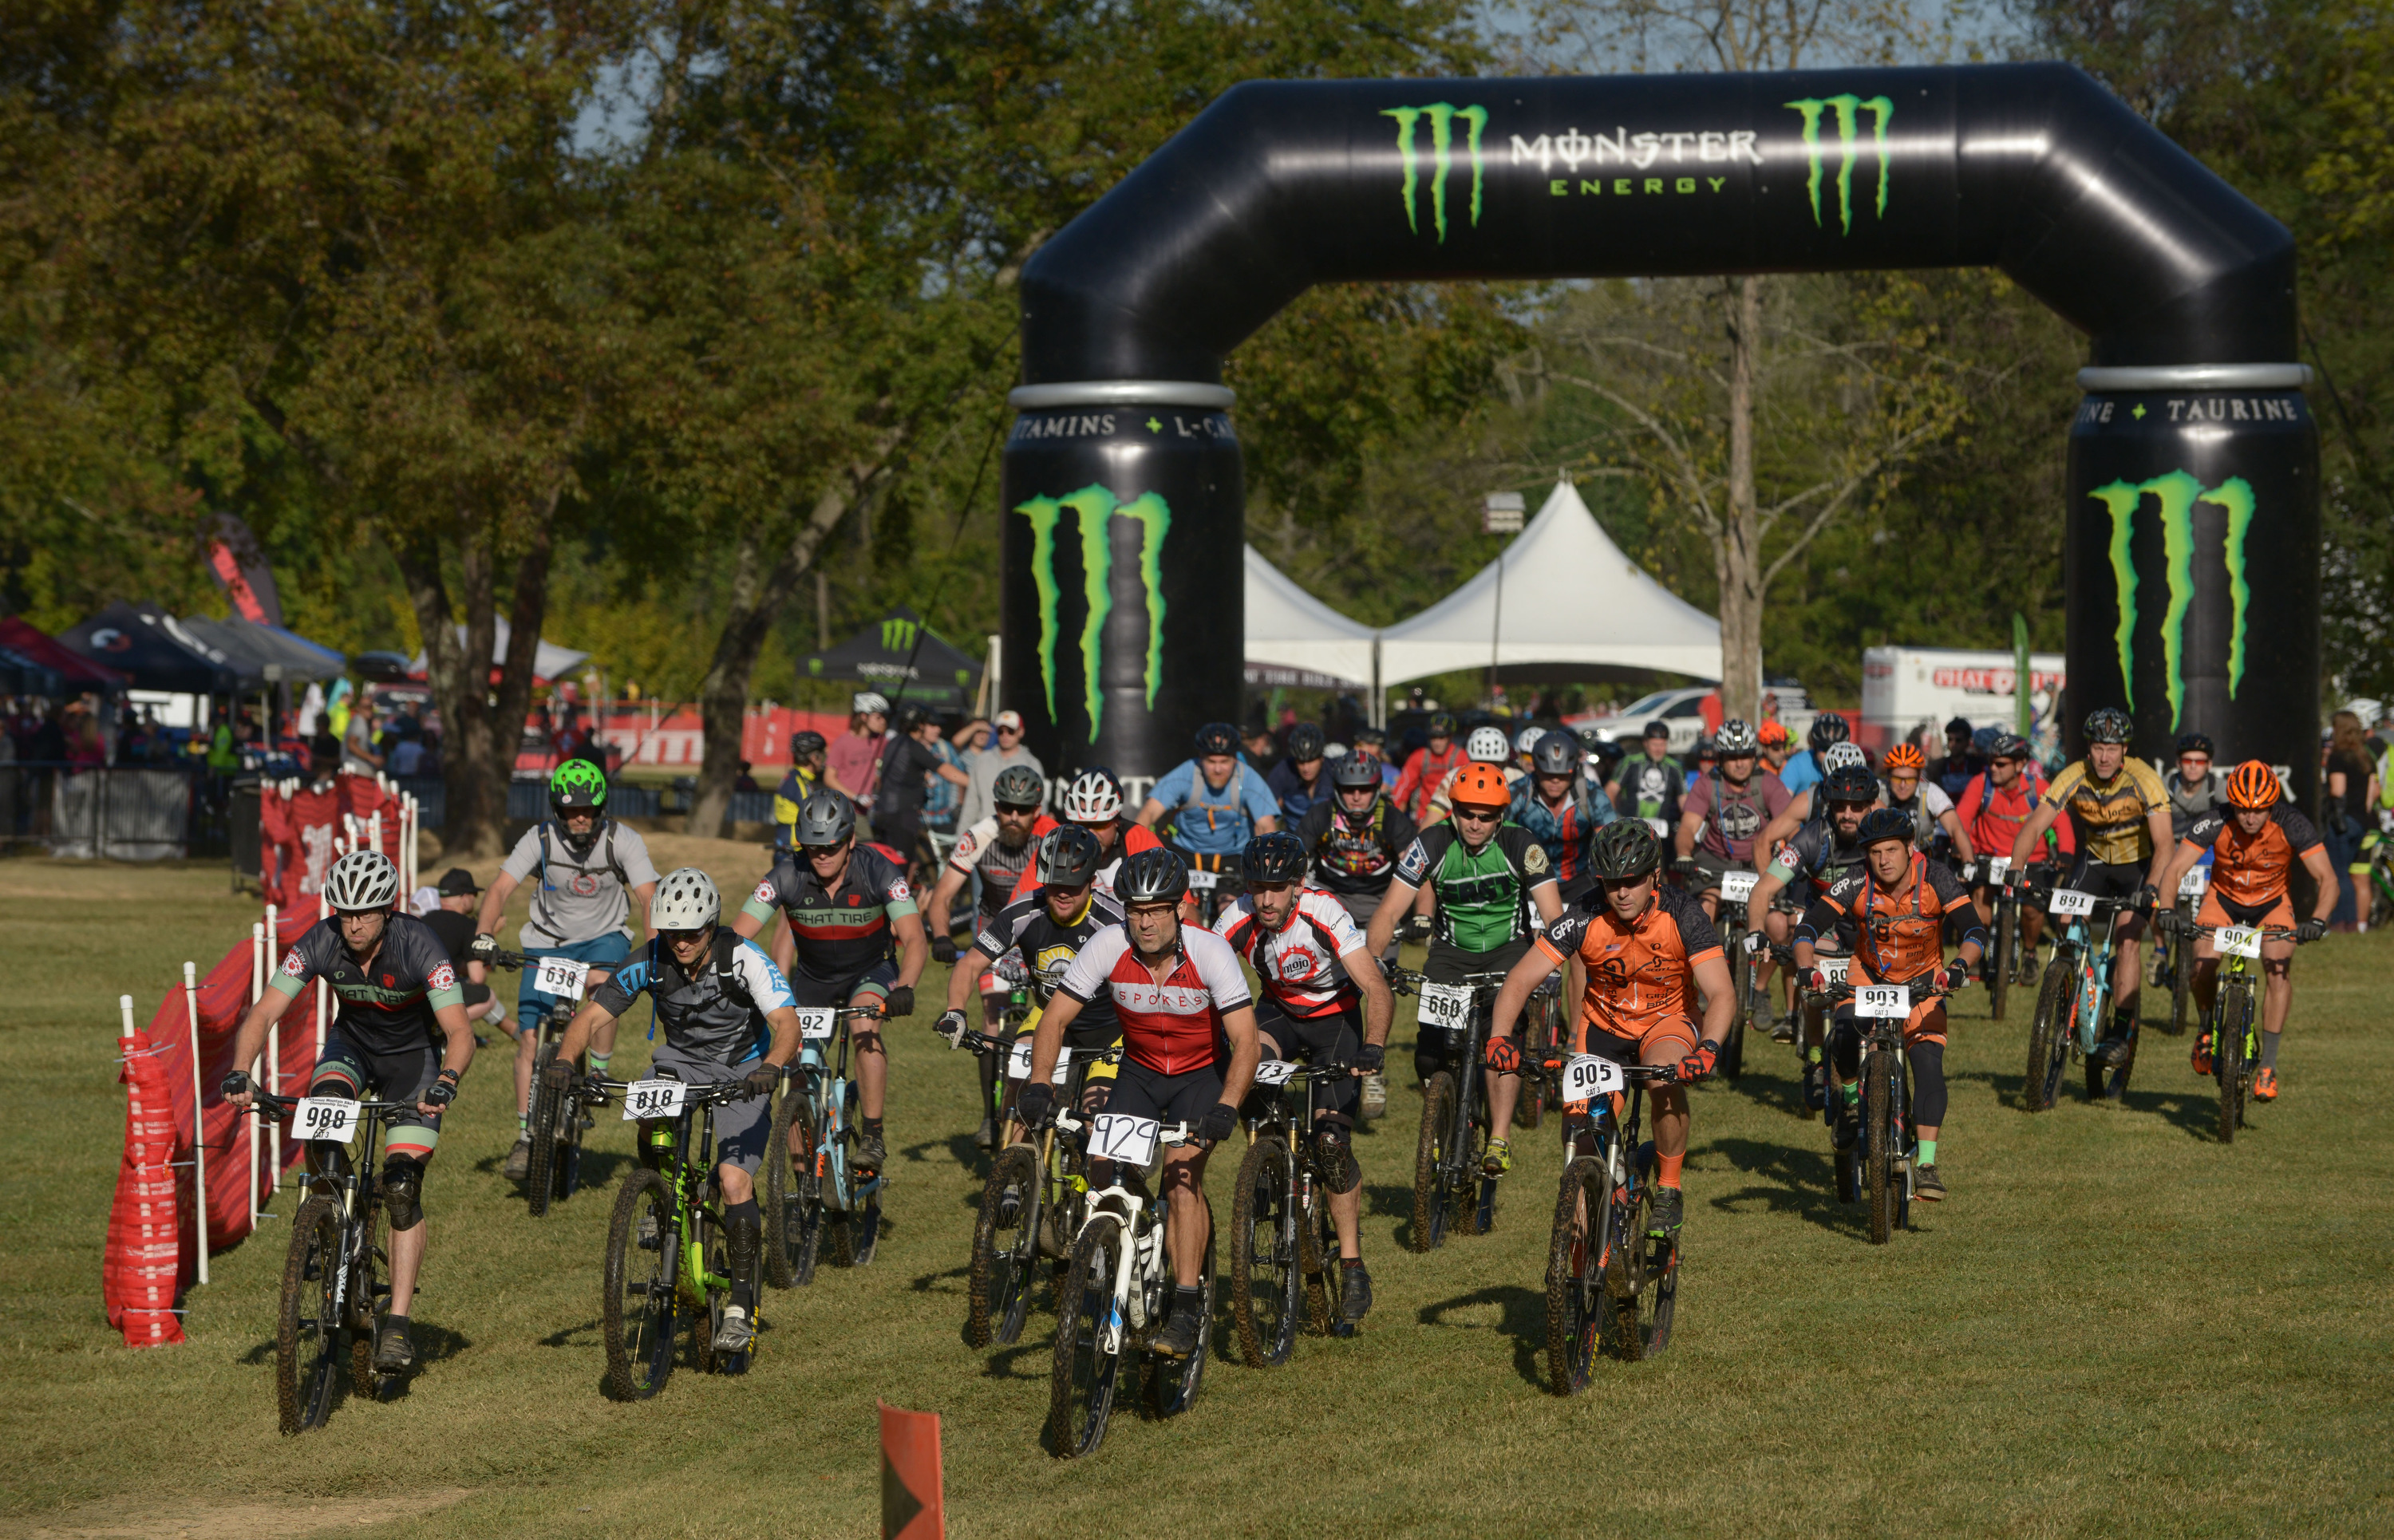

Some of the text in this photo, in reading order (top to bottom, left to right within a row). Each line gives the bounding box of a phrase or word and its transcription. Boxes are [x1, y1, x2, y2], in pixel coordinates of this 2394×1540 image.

[1510, 126, 1764, 173] MONSTER
[1550, 176, 1726, 196] ENERGY
[2167, 399, 2297, 421] TAURINE
[2192, 819, 2211, 835] GPP
[1830, 878, 1851, 896] GPP
[2059, 895, 2086, 908] 891
[839, 912, 872, 923] TIRE
[1551, 918, 1575, 941] GPP
[1283, 958, 1309, 974] mojo
[546, 966, 576, 988] 638
[334, 988, 368, 998] HAT
[1119, 991, 1203, 1008] SPOKES
[1865, 990, 1898, 1007] 903
[1428, 995, 1460, 1018] 660
[798, 1015, 824, 1030] 92
[1573, 1064, 1612, 1088] 905
[636, 1089, 674, 1109] 818
[1586, 1088, 1596, 1097] CAT
[306, 1107, 346, 1129] 988
[1095, 1115, 1159, 1163] 929
